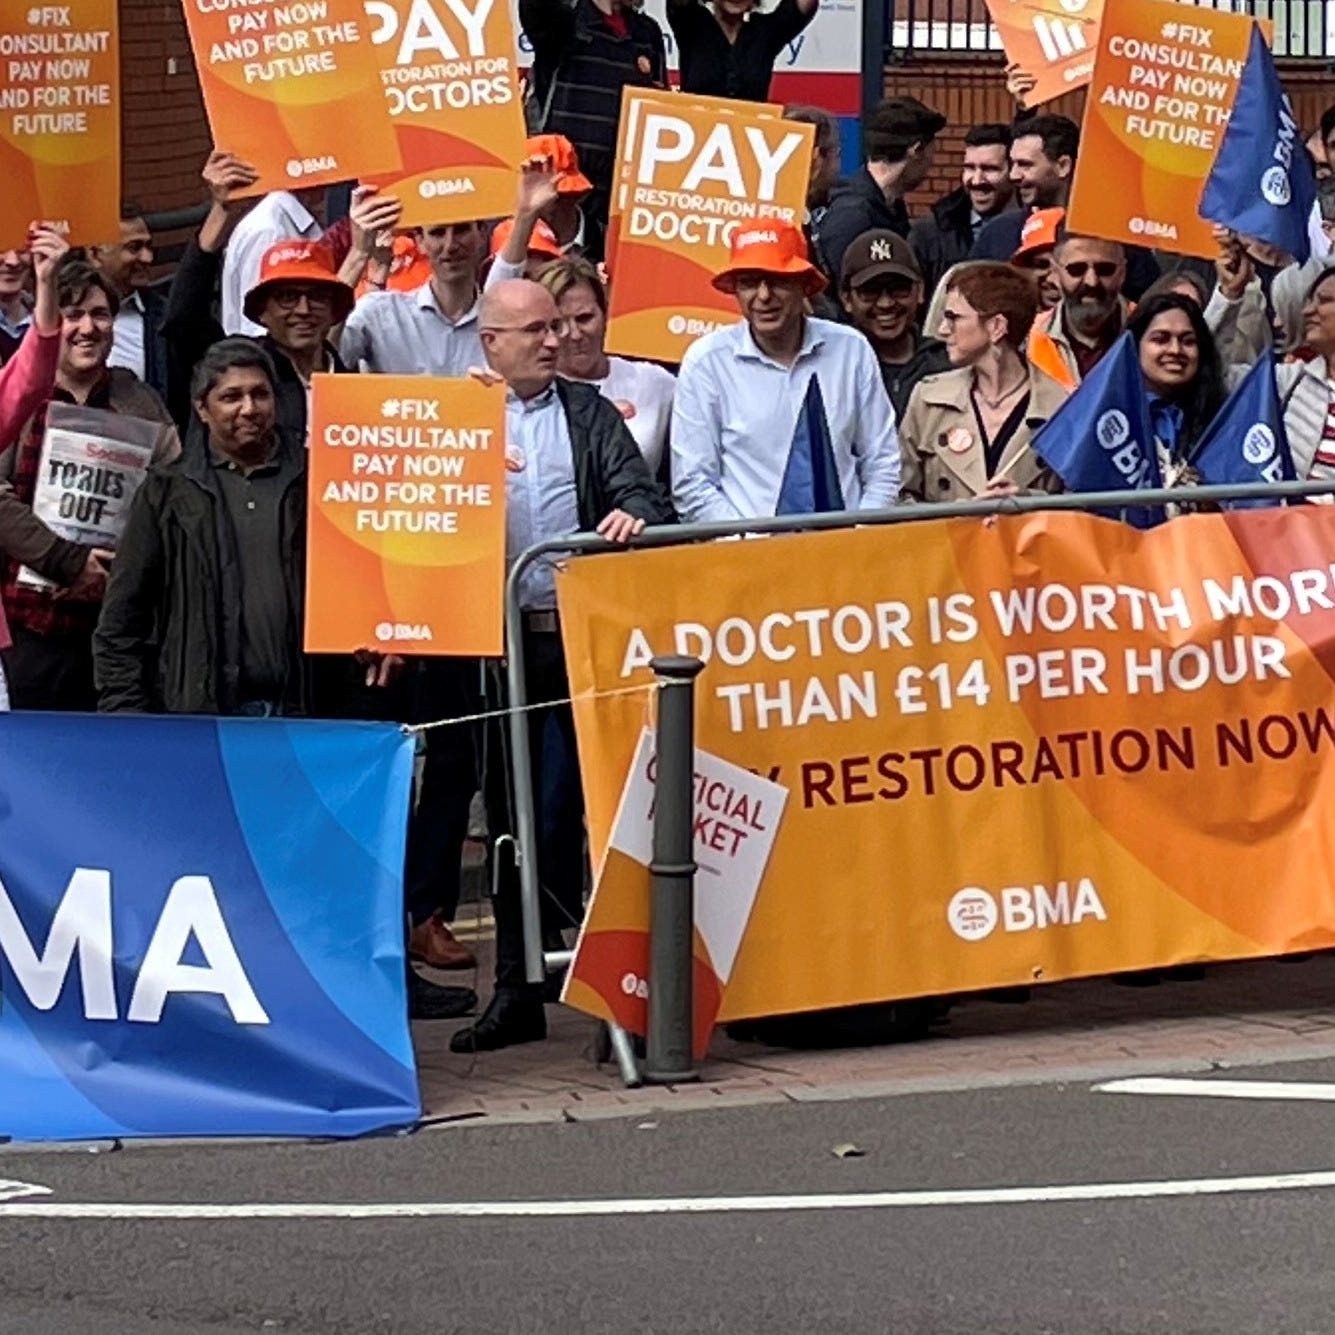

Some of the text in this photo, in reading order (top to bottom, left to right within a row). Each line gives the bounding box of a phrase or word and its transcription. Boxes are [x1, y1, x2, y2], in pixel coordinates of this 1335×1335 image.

[27, 7, 70, 27] #FIX
[228, 2, 328, 35] PAY NOW
[210, 22, 361, 65] AND FOR THE
[1161, 22, 1213, 48] #FIX
[8, 59, 90, 82] PAY NOW
[244, 52, 337, 84] FUTURE
[474, 57, 510, 74] FOR
[1109, 36, 1245, 79] CONSULTAN
[33, 87, 70, 107] FOR
[74, 86, 110, 105] THE
[1129, 65, 1228, 100] PAY NOW
[1100, 85, 1232, 126] AND FOR TH
[12, 113, 87, 135] FUTURE
[1126, 114, 1216, 150] FUTURE
[301, 156, 337, 174] BMA
[637, 113, 803, 201] PAY
[434, 178, 475, 196] BMA
[634, 187, 796, 224] RESTORATION FOR
[1146, 222, 1177, 241] BMA
[381, 399, 439, 422] #FIX
[324, 425, 493, 451] CONSULTANT
[49, 459, 124, 499] TORIES
[352, 453, 464, 478] PAY NOW
[59, 492, 108, 525] OUT
[323, 482, 492, 507] AND FOR THE
[356, 510, 458, 533] FUTURE
[394, 624, 432, 641] BMA
[620, 628, 654, 678] A
[674, 601, 913, 665] DOCTOR
[927, 593, 979, 644] IS
[990, 582, 1192, 638] WORTH
[715, 634, 1291, 732] THAN £14 PER HOUR
[801, 726, 1194, 809] RESTORATION
[1001, 878, 1107, 932] BMA
